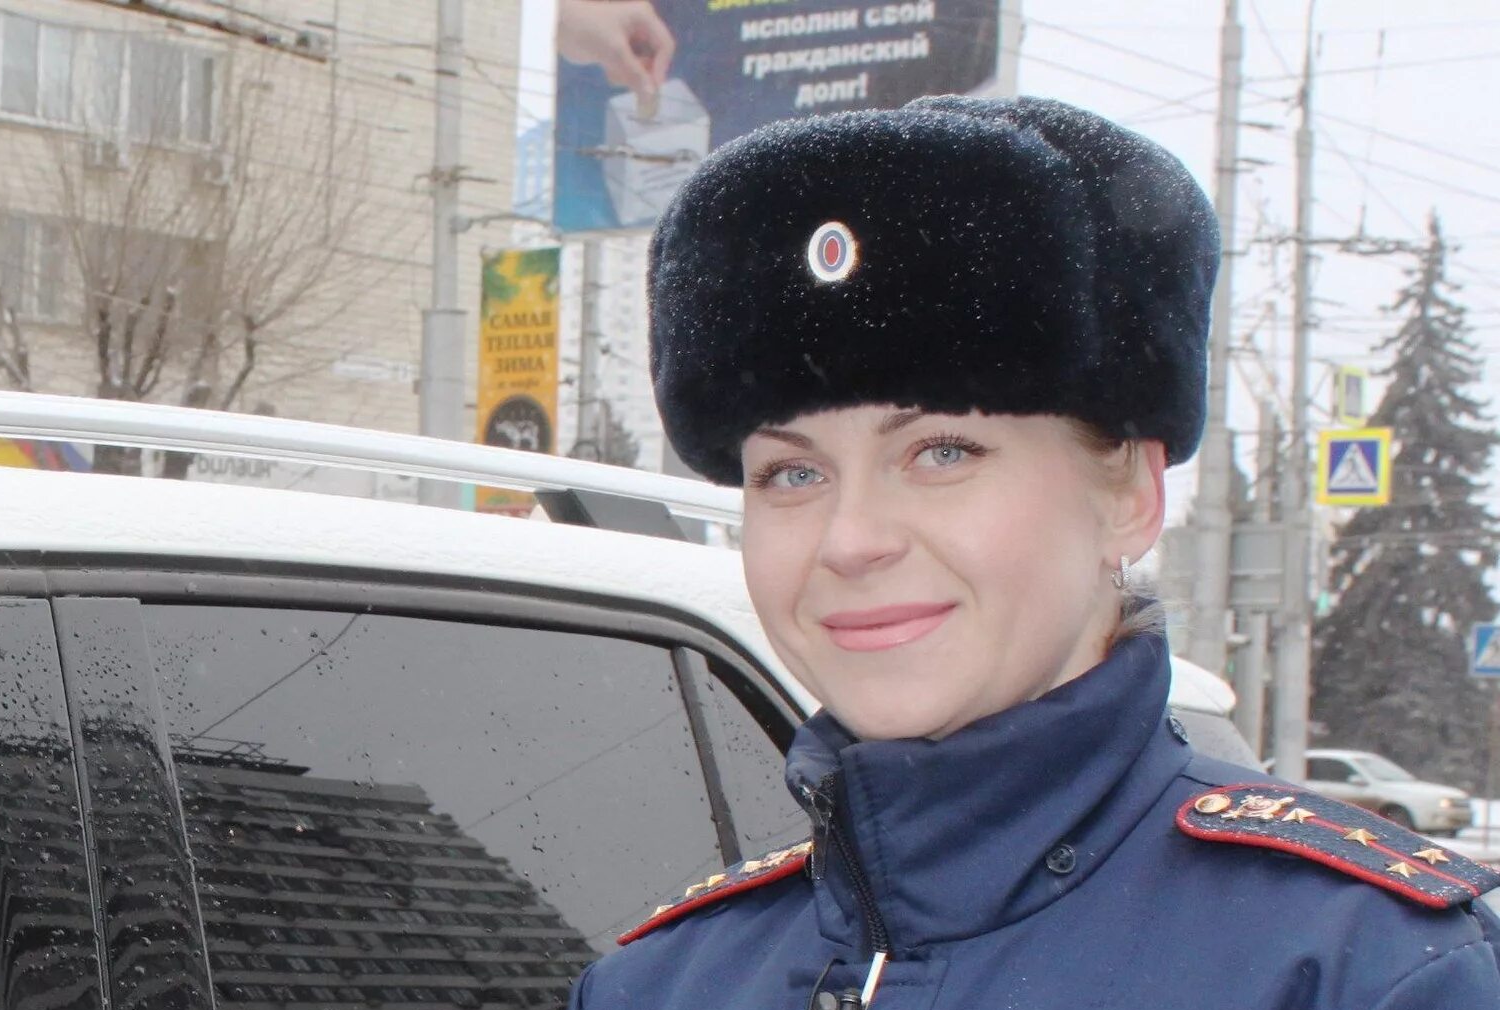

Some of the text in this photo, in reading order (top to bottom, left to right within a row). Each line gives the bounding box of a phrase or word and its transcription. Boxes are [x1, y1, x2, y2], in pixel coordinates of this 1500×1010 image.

[740, 0, 936, 41] исполни свой
[741, 31, 930, 79] гражданский
[795, 72, 868, 109] долг!
[489, 311, 552, 330] САМАЯ
[486, 332, 555, 352] ТЕПЛАЯ
[494, 356, 546, 374] ЗИМА
